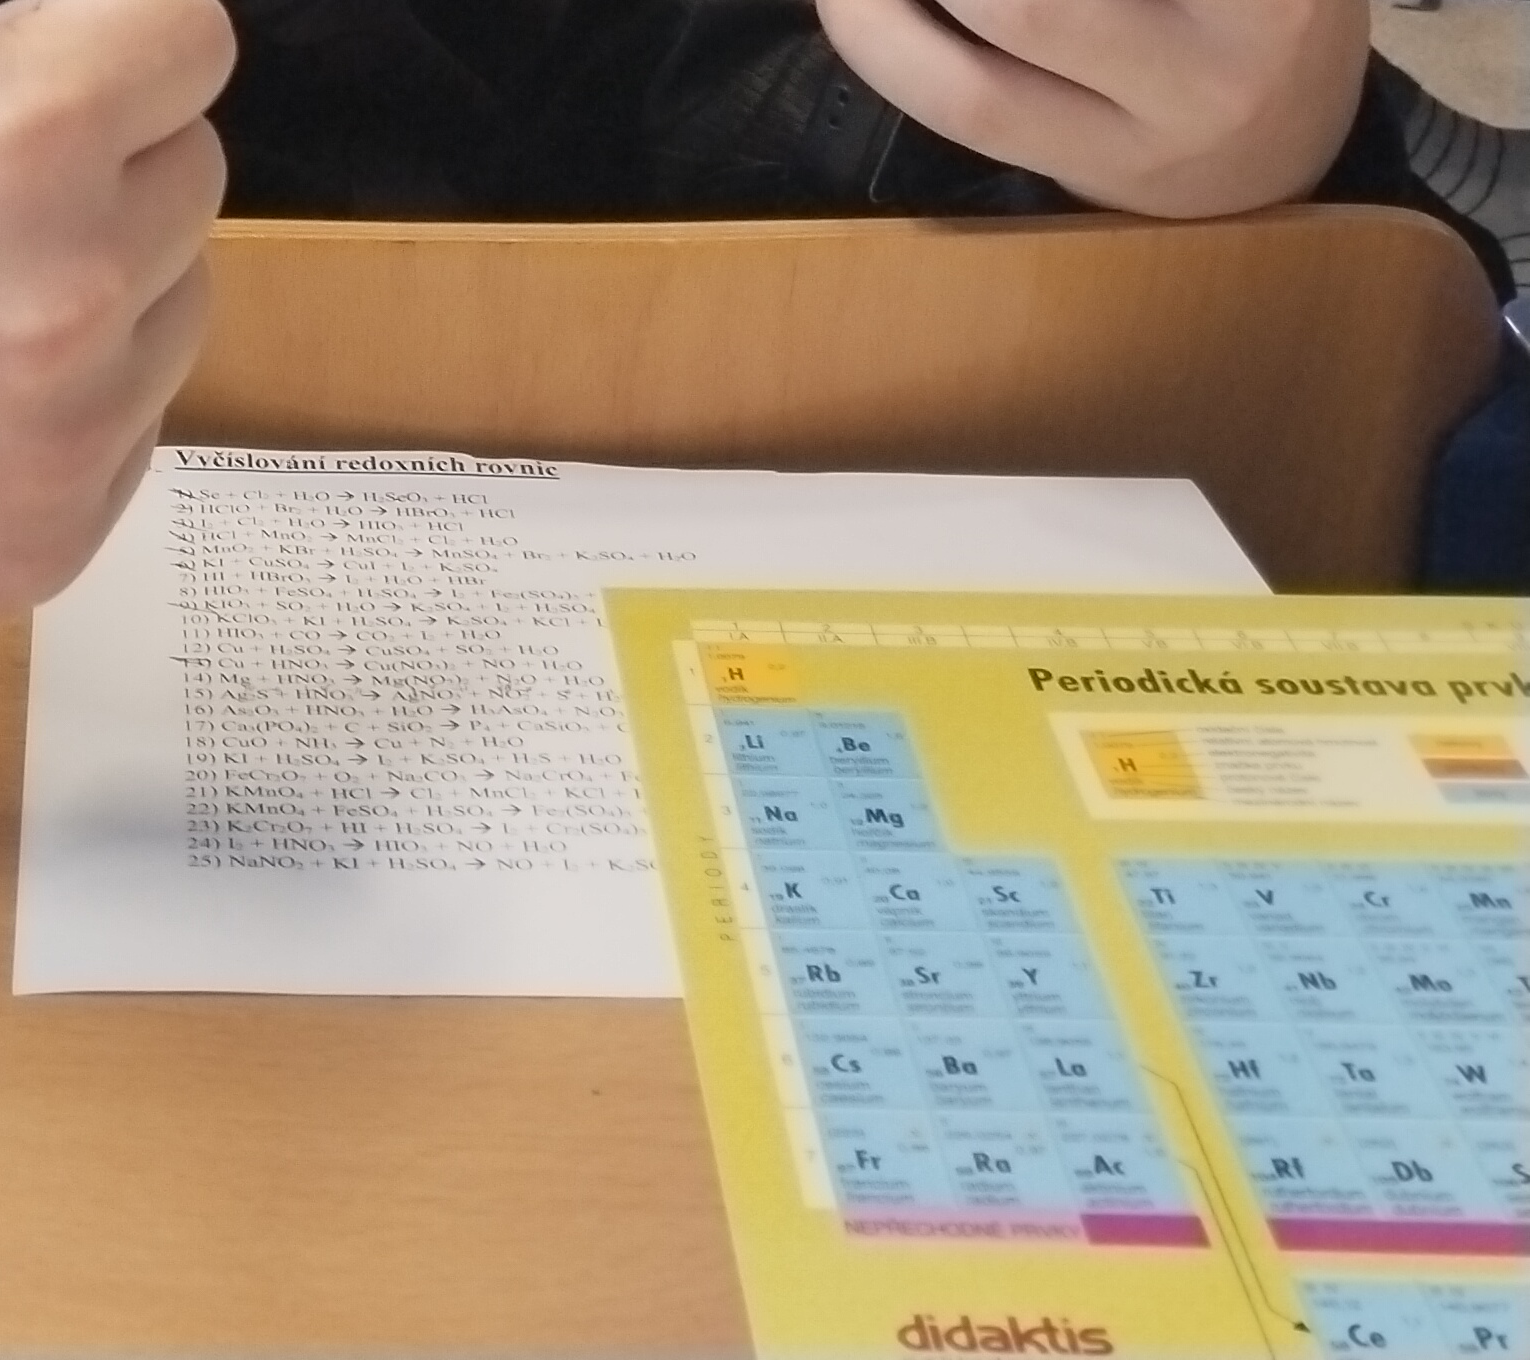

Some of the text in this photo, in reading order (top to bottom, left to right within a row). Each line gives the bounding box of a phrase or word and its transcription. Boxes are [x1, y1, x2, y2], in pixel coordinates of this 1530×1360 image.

[175, 449, 559, 477] Vyčíslování redoxních rovnic
[453, 494, 488, 504] HCl
[480, 509, 515, 519] HCl
[429, 522, 463, 531] HCl
[279, 545, 316, 556] KBr
[183, 615, 209, 625] 10)
[183, 629, 210, 639] 11)
[290, 631, 321, 640] CO
[184, 643, 211, 654] 12)
[218, 643, 244, 654] Cu
[219, 659, 244, 669] Cu
[483, 659, 515, 669] NO
[185, 673, 212, 684] 14)
[728, 667, 744, 680] H
[1028, 668, 1244, 695] Periodická
[1255, 676, 1438, 696] soustava
[186, 688, 213, 699] 15)
[185, 705, 214, 716] 16)
[186, 721, 214, 731] 17)
[345, 722, 360, 732] C
[187, 737, 215, 748] 18)
[223, 738, 267, 748] CuO
[375, 738, 402, 749] Cu
[744, 734, 764, 750] Li
[841, 737, 871, 752] Be
[187, 753, 216, 764] 19)
[186, 770, 217, 781] 20)
[186, 787, 218, 798] 21)
[332, 788, 371, 799] HCl
[187, 804, 219, 815] 22)
[764, 805, 798, 822] Na
[864, 808, 905, 828] Mg
[187, 821, 220, 833] 23)
[188, 838, 220, 850] 24)
[458, 840, 492, 852] NO
[188, 856, 221, 868] 25)
[498, 858, 533, 870] NO
[784, 882, 802, 899] K
[889, 884, 921, 901] Ca
[992, 886, 1021, 903] Sc
[1255, 889, 1275, 906] V
[1364, 891, 1391, 908] Cr
[1469, 892, 1513, 910] Mn
[806, 965, 842, 983] Rb
[914, 967, 942, 984] Sr
[1022, 967, 1039, 985] Y
[830, 1054, 862, 1073] Cs
[942, 1055, 978, 1076] Ba
[1055, 1058, 1088, 1078] La
[1456, 1064, 1488, 1084] W
[855, 1149, 881, 1170] Fr
[973, 1152, 1012, 1173] Ra
[1093, 1154, 1126, 1176] Ac
[896, 1314, 1114, 1356] didaktis
